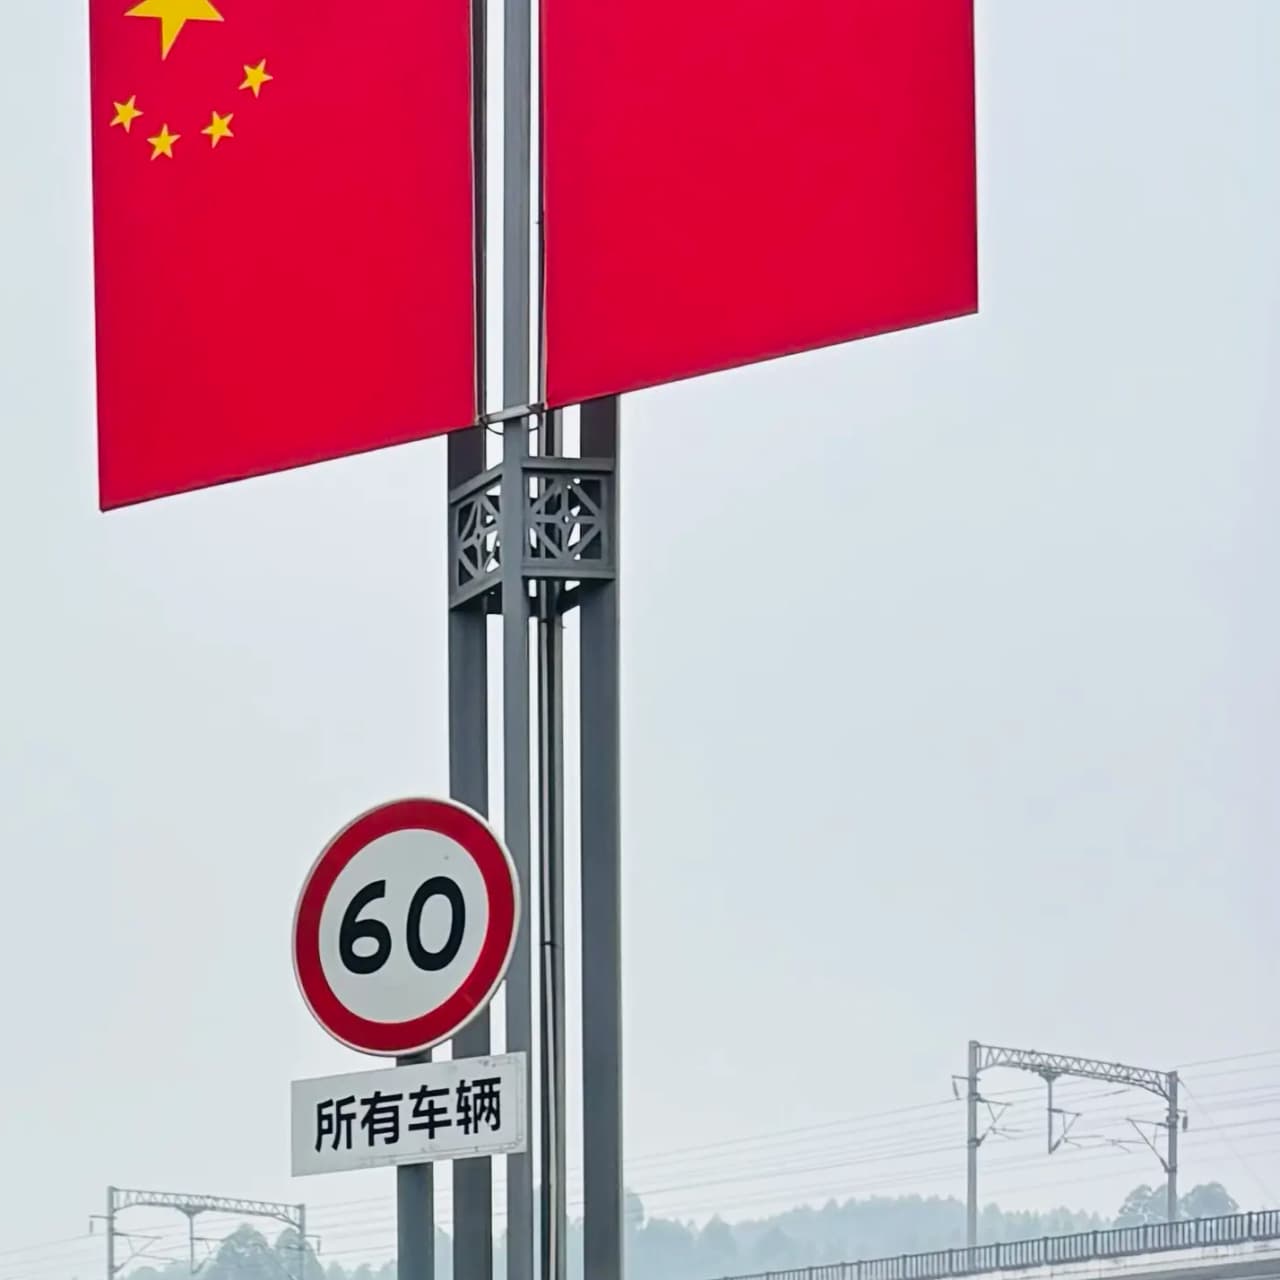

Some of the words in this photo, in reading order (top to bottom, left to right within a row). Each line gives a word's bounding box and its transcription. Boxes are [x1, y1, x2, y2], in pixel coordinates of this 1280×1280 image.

[339, 876, 466, 975] 60
[314, 1076, 502, 1153] 所有车辆
